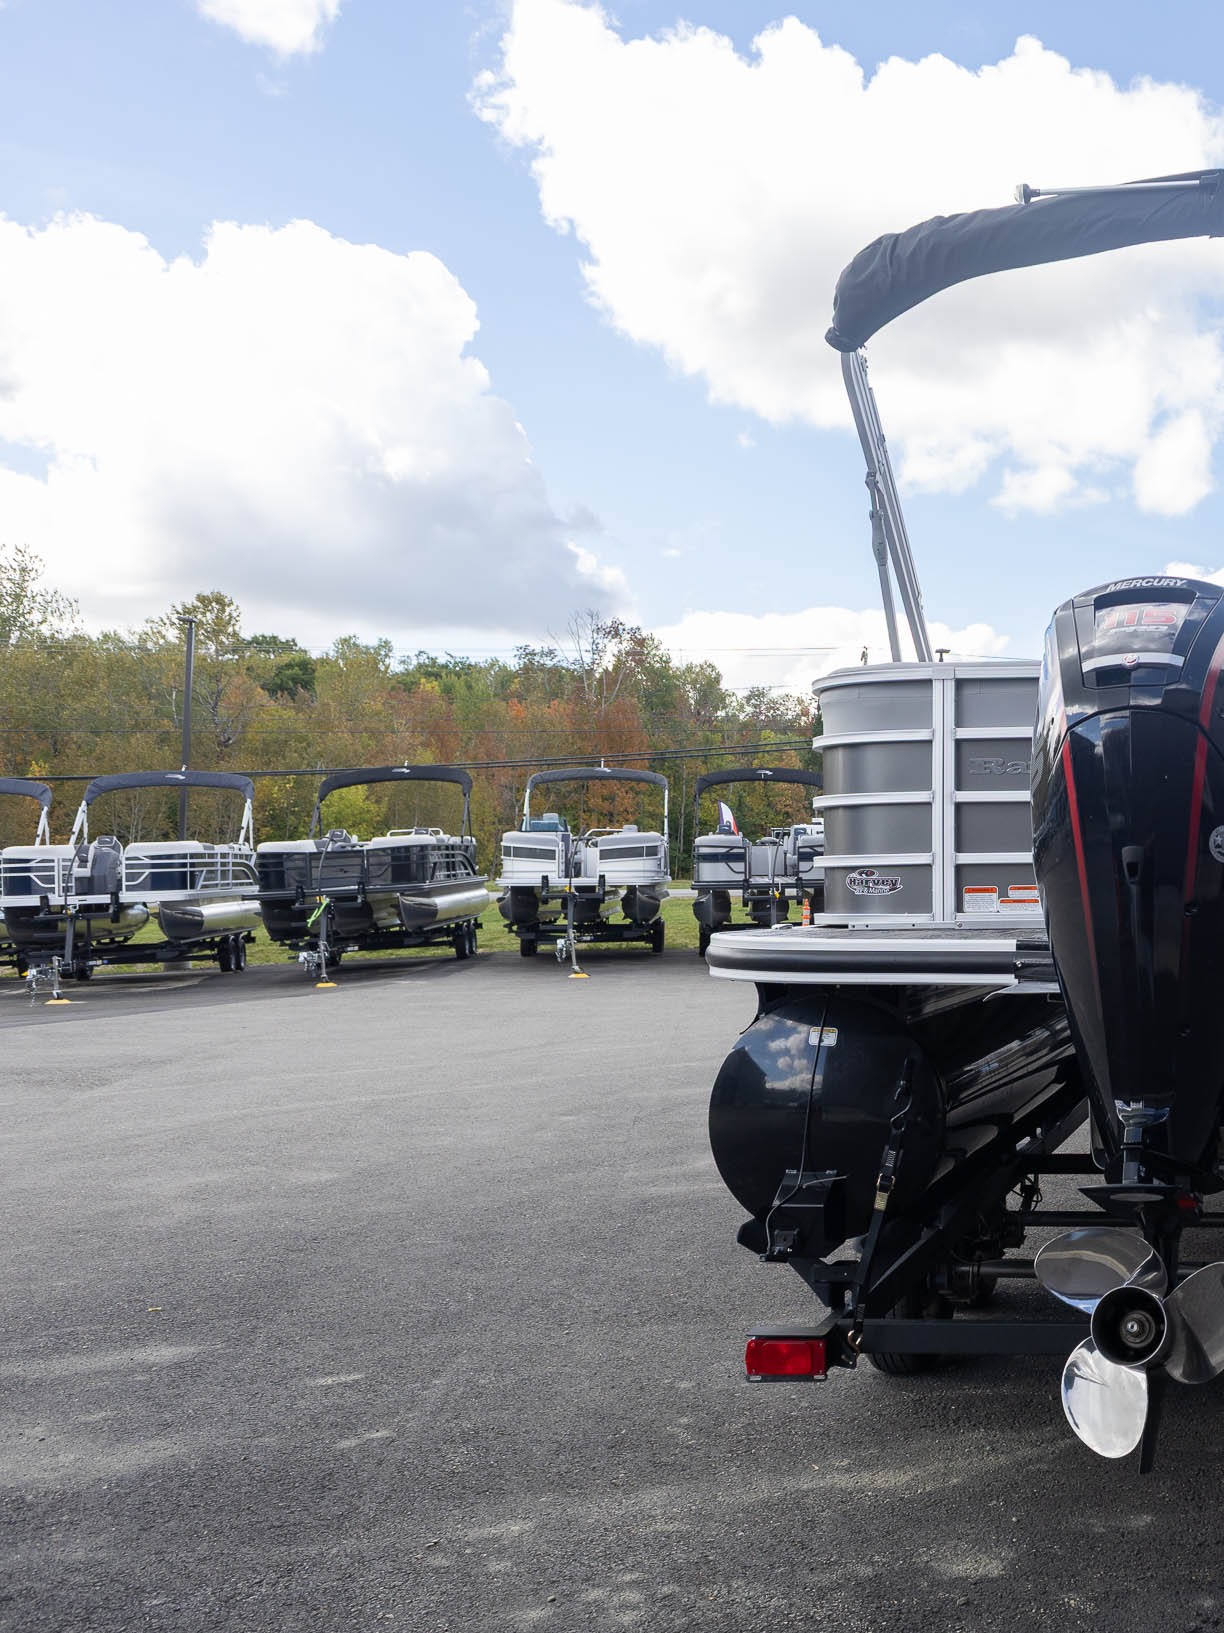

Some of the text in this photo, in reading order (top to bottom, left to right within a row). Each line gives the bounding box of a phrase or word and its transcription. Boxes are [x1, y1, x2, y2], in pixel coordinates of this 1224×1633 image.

[1105, 578, 1187, 592] MERCURY
[1103, 608, 1177, 629] 115
[849, 878, 898, 887] Harvey
